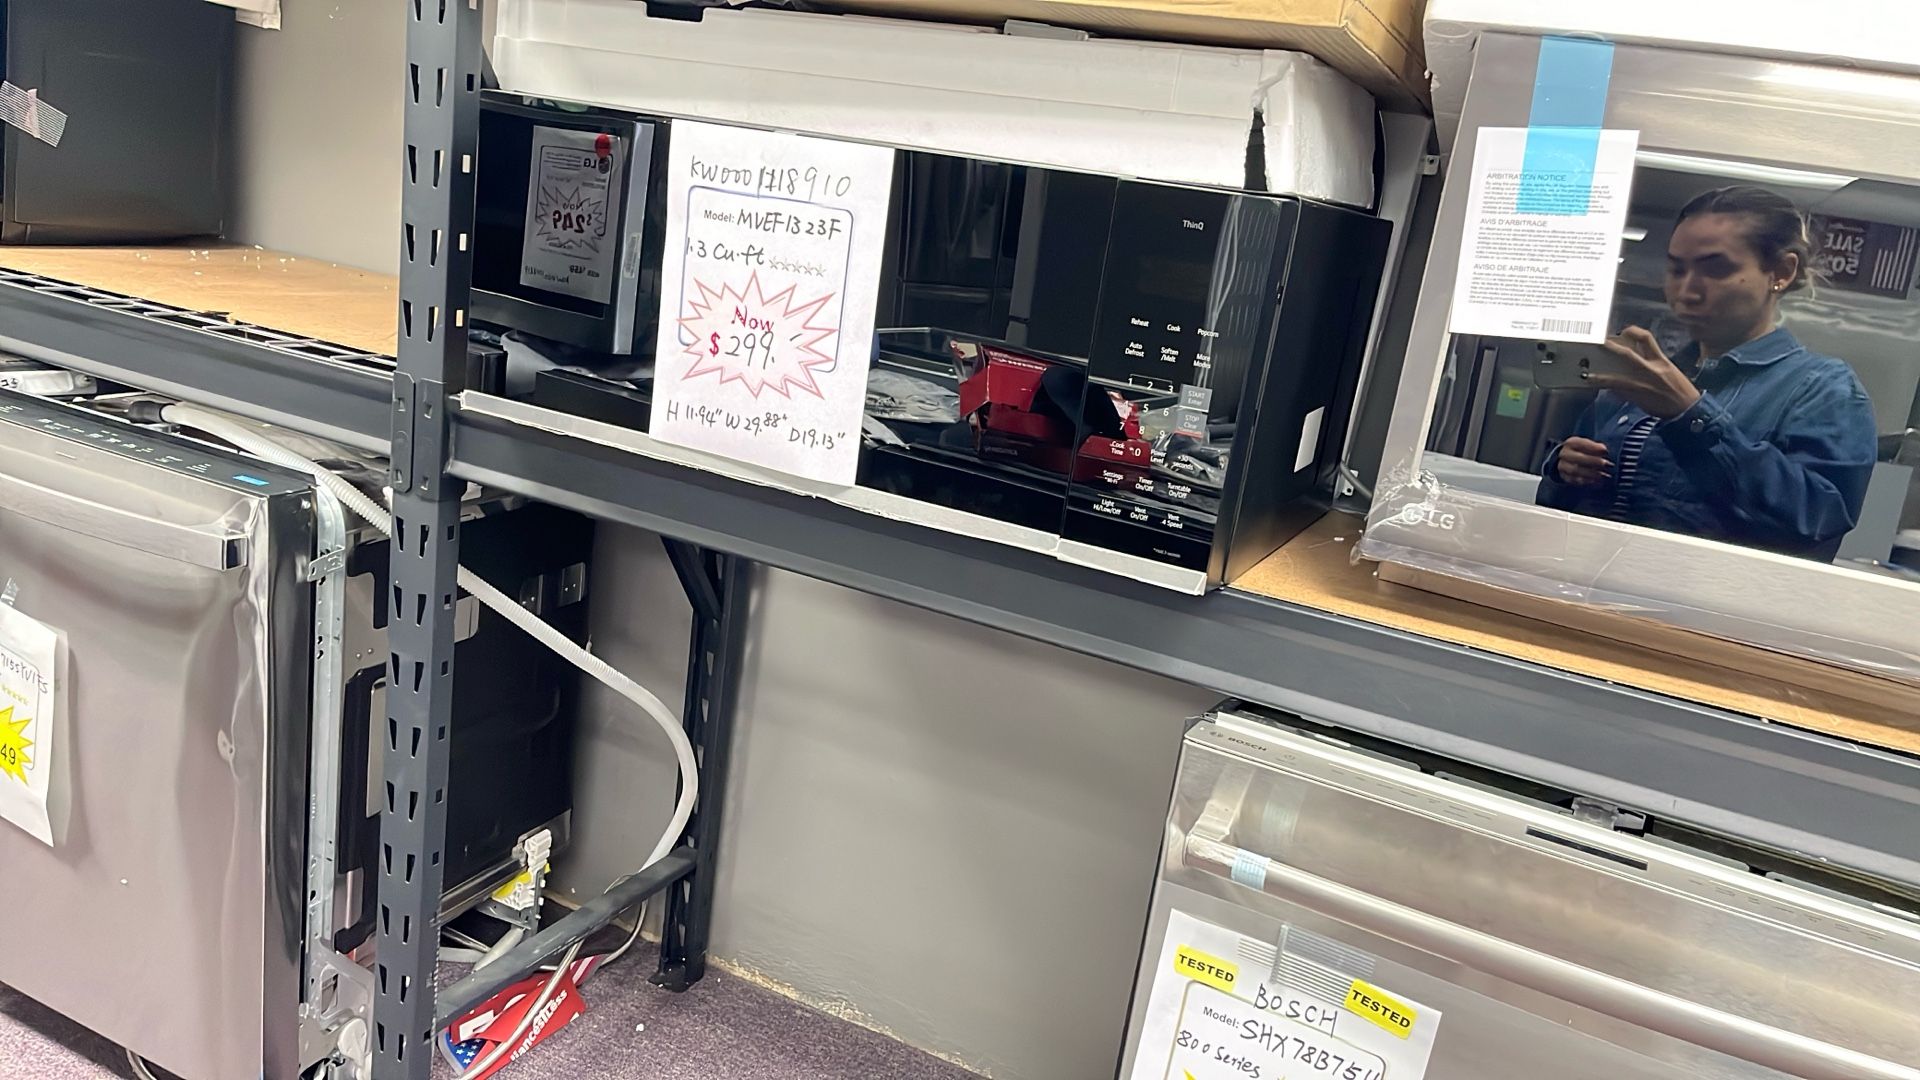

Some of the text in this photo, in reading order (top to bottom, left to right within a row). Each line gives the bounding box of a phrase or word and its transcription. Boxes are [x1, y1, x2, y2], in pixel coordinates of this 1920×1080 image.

[1487, 173, 1567, 182] ARBITRATION NOTICE
[703, 209, 842, 240] Model: MVEF1323F
[1183, 219, 1204, 231] ThinQ
[1480, 218, 1548, 228] AVIS D'ARBITRAGE
[1474, 264, 1496, 272] AVISO
[1509, 265, 1550, 274] ARBITRAJE
[731, 306, 774, 332] Now
[1131, 317, 1150, 328] Reheat
[1166, 323, 1181, 332] Cook
[1197, 328, 1219, 338] Popcorn
[1129, 341, 1143, 350] Auto
[1124, 348, 1145, 358] Defrost
[1161, 346, 1179, 356] Soften
[1196, 353, 1211, 362] More
[1193, 360, 1212, 369] Modes
[1147, 381, 1153, 391] 2
[1168, 385, 1174, 394] 3
[1188, 391, 1206, 399] START
[1188, 398, 1203, 406] Enter
[1143, 403, 1149, 413] 5
[1163, 407, 1169, 416] 6
[667, 400, 678, 422] H
[725, 412, 740, 430] W
[1185, 414, 1200, 422] STOP
[1139, 426, 1145, 435] 8
[1183, 421, 1198, 430] Clear
[1111, 440, 1125, 449] Cook
[1111, 447, 1124, 456] Time
[1150, 448, 1167, 458] Power
[1150, 455, 1164, 464] Level
[1173, 461, 1194, 471] seconds
[1102, 470, 1124, 481] Settings
[1138, 476, 1154, 485] Timer
[1135, 483, 1154, 493] On/Off
[1167, 482, 1191, 494] Turntable
[1168, 490, 1188, 499] On/Off
[1101, 499, 1115, 508] Light
[1093, 504, 1122, 516] Hi/Low/Off
[1134, 506, 1147, 514] Vent
[1130, 511, 1149, 521] On/Off
[1167, 512, 1180, 522] Vent
[1427, 509, 1456, 530] LG
[1166, 520, 1183, 530] Speed
[1228, 737, 1267, 751] BOSCH
[1178, 953, 1235, 984] TESTED
[1254, 983, 1339, 1038] BOSCH
[1352, 989, 1411, 1029] TESTED
[1202, 1006, 1241, 1030] Model:
[1176, 1029, 1261, 1079] 800 Series
